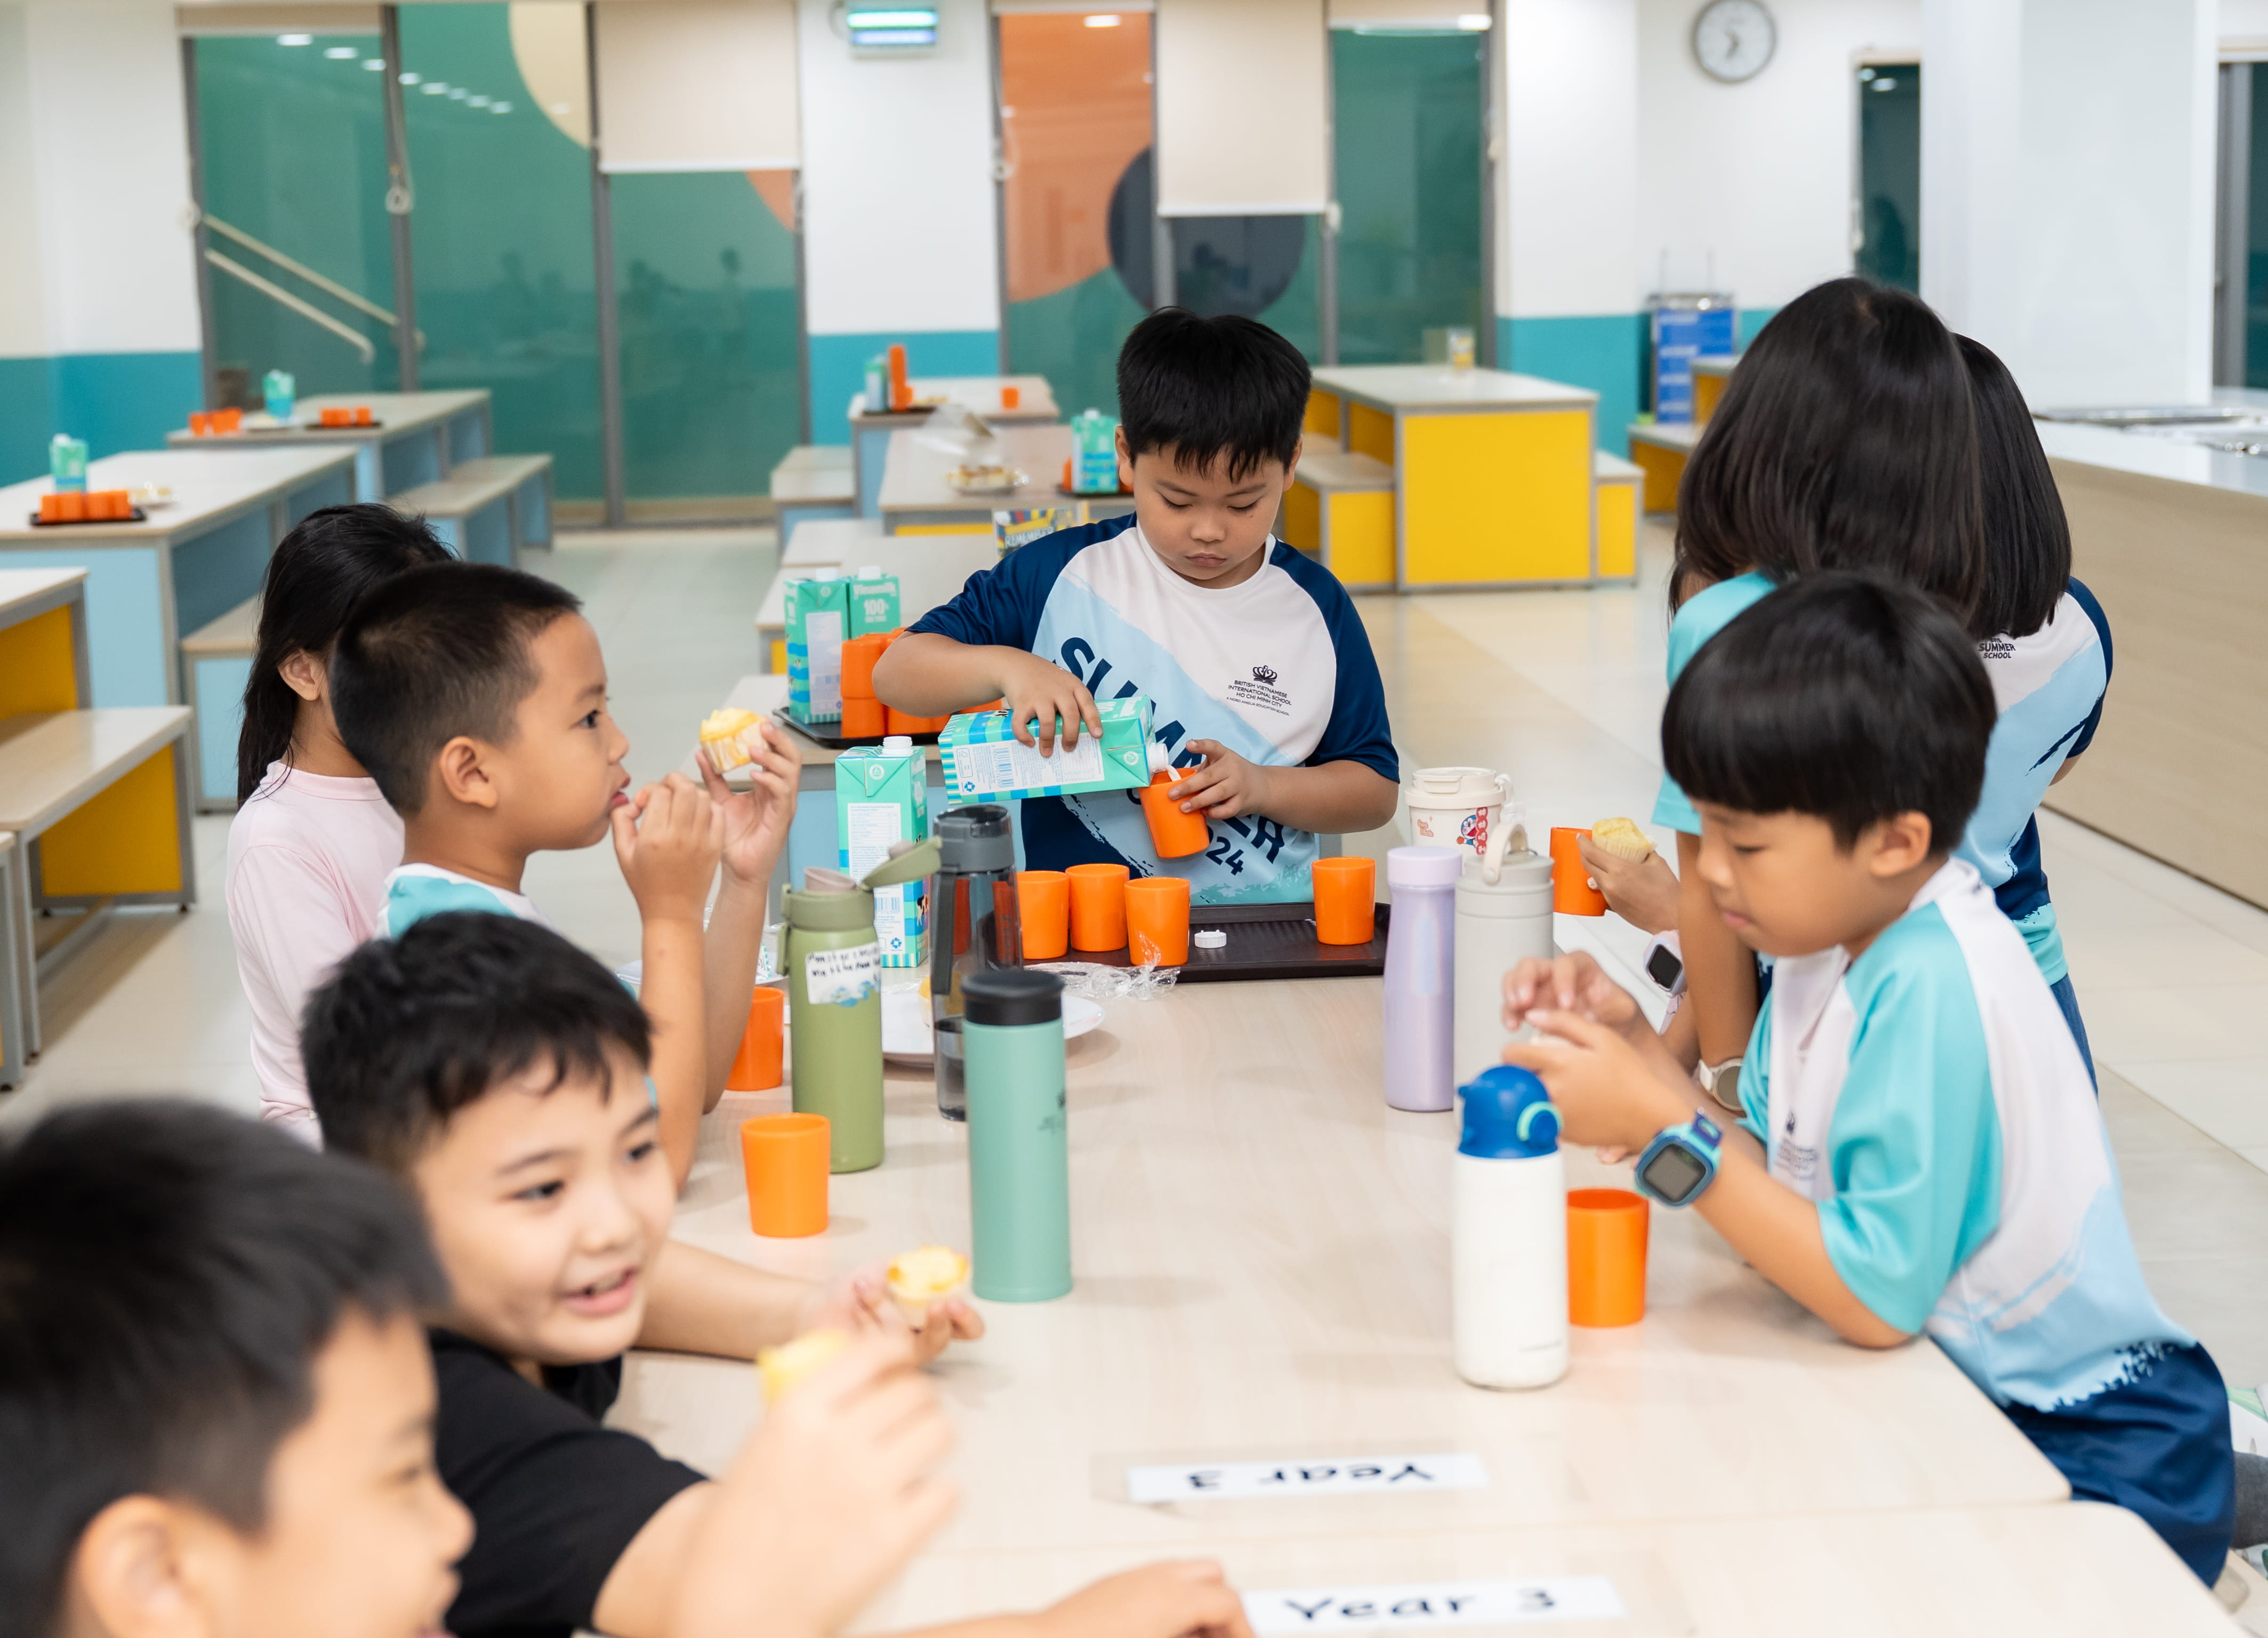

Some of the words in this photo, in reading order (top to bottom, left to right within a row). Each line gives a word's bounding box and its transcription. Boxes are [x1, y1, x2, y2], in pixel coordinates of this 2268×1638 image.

[1979, 643, 2016, 652] SUMMER
[1228, 685, 1270, 698] INTERNATIONAL
[1272, 695, 1292, 705] SCHOOL
[1256, 684, 1288, 698] VIETNAMESE
[1188, 1470, 1222, 1491] 3
[1259, 1463, 1435, 1486] Year
[1284, 1595, 1477, 1620] Year
[1517, 1587, 1555, 1613] 3
